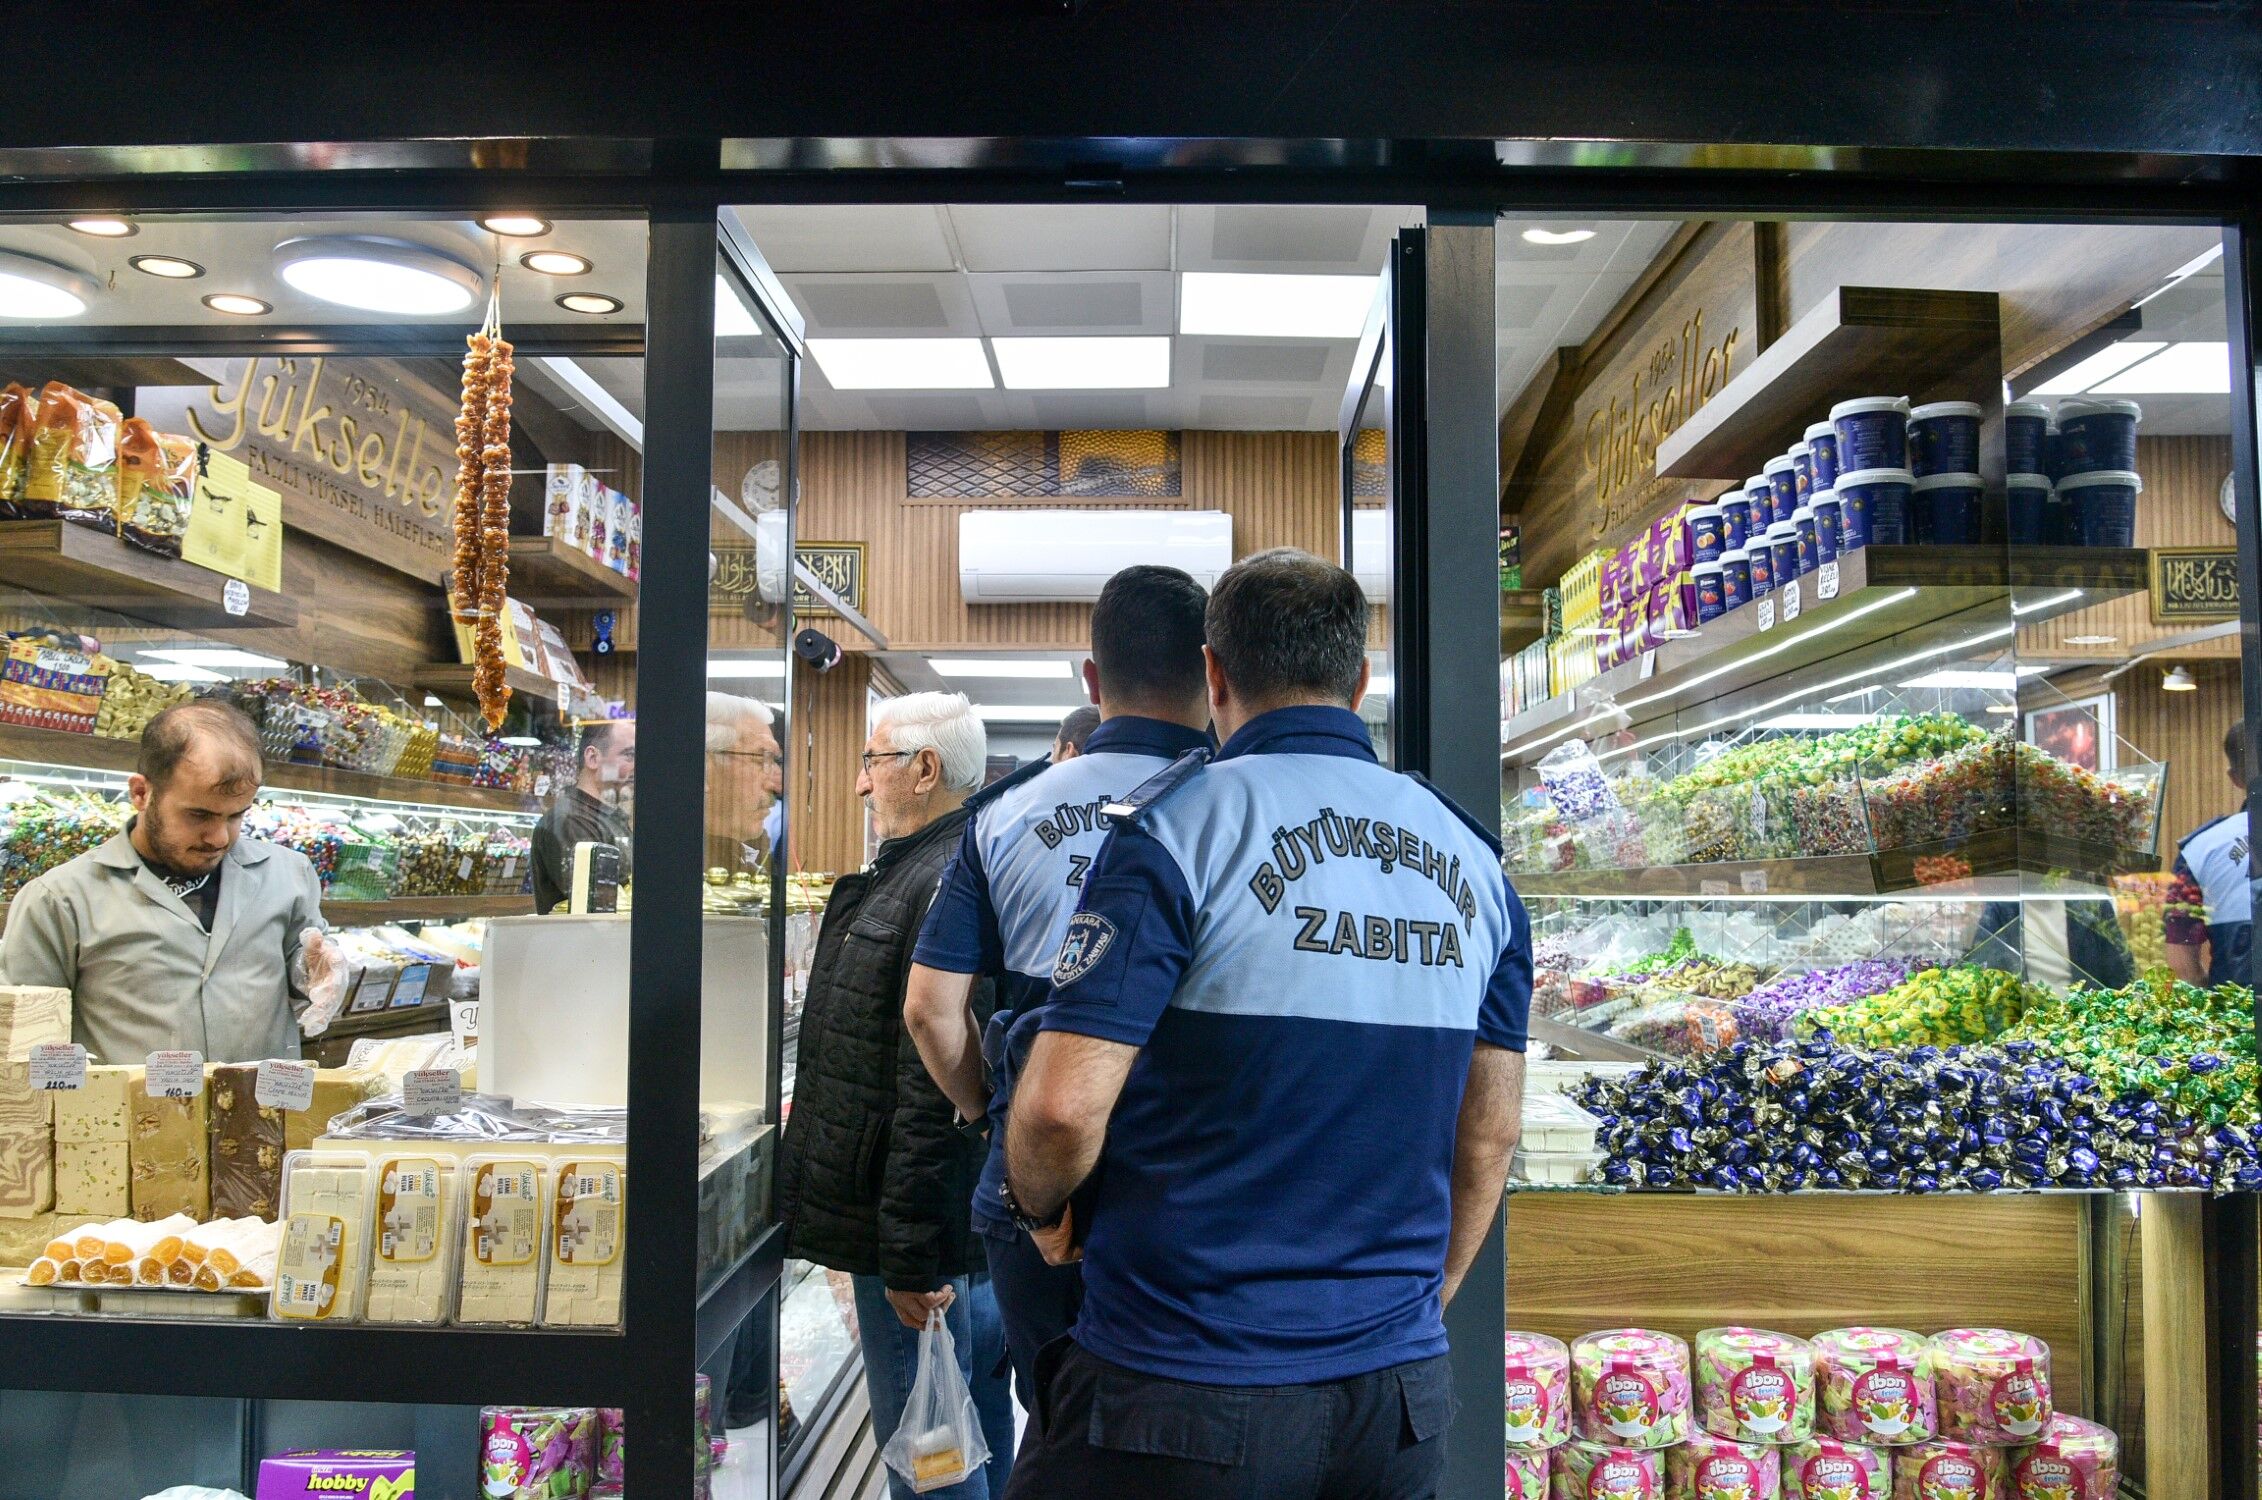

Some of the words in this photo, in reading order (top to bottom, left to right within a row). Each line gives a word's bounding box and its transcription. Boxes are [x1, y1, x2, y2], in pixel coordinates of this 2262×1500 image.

[186, 357, 460, 528] Yükselle
[1034, 795, 1112, 850] BÜYÜ
[1249, 808, 1478, 936] BÜYÜKŞEHİR
[1294, 906, 1464, 969] ZABITA
[1606, 1378, 1644, 1394] ibon
[1745, 1373, 1784, 1389] ibon
[1867, 1375, 1907, 1390] ibon
[1505, 1382, 1537, 1399] bon
[488, 1433, 519, 1451] ibon
[1603, 1462, 1640, 1478] ibon
[1709, 1460, 1748, 1476] ibon
[1814, 1457, 1855, 1474] ibon
[1937, 1459, 1976, 1475] ibon
[2031, 1458, 2071, 1474] ibon
[306, 1473, 369, 1493] hobby
